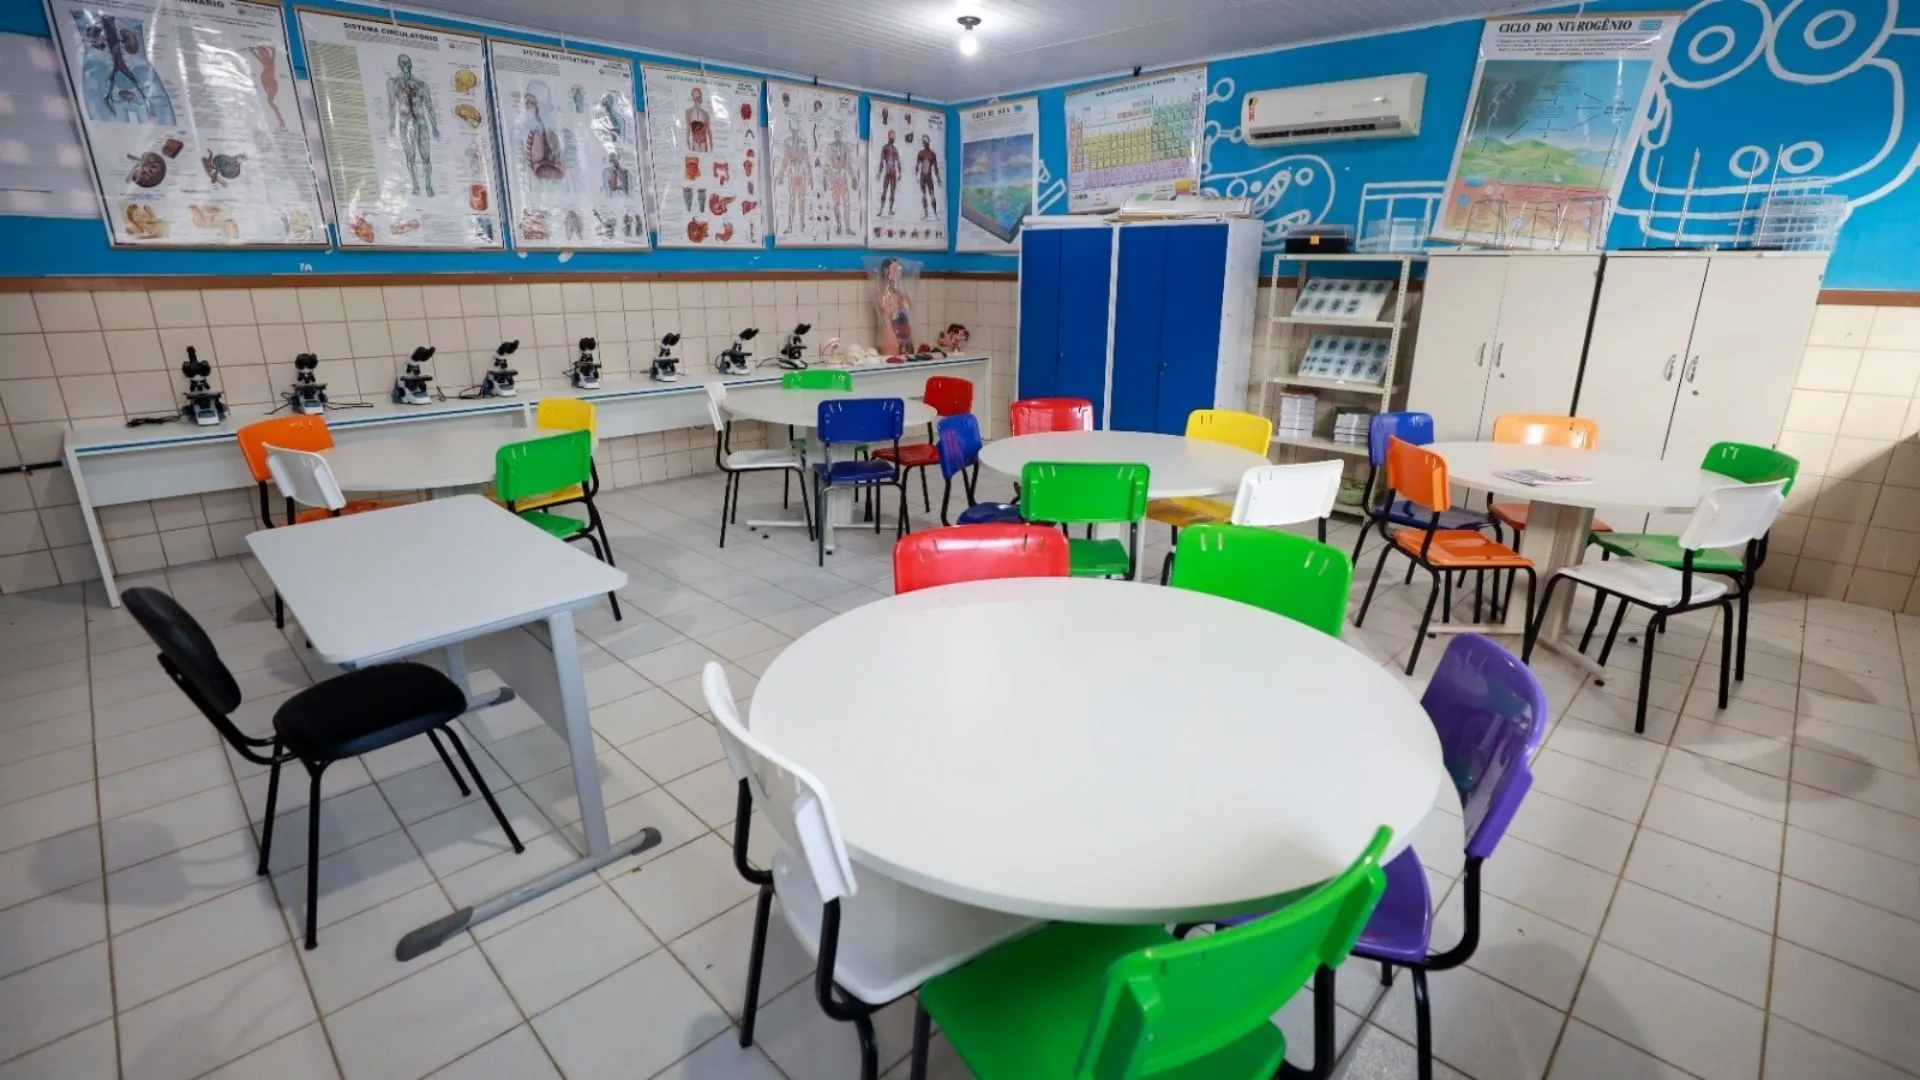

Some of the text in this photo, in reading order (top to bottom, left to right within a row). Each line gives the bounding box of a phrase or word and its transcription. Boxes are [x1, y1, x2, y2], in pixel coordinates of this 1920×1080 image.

[343, 22, 379, 34] SISTEMA
[1498, 22, 1531, 33] CICLO
[1535, 22, 1553, 33] DO
[1556, 16, 1633, 33] NITROGÊNIO
